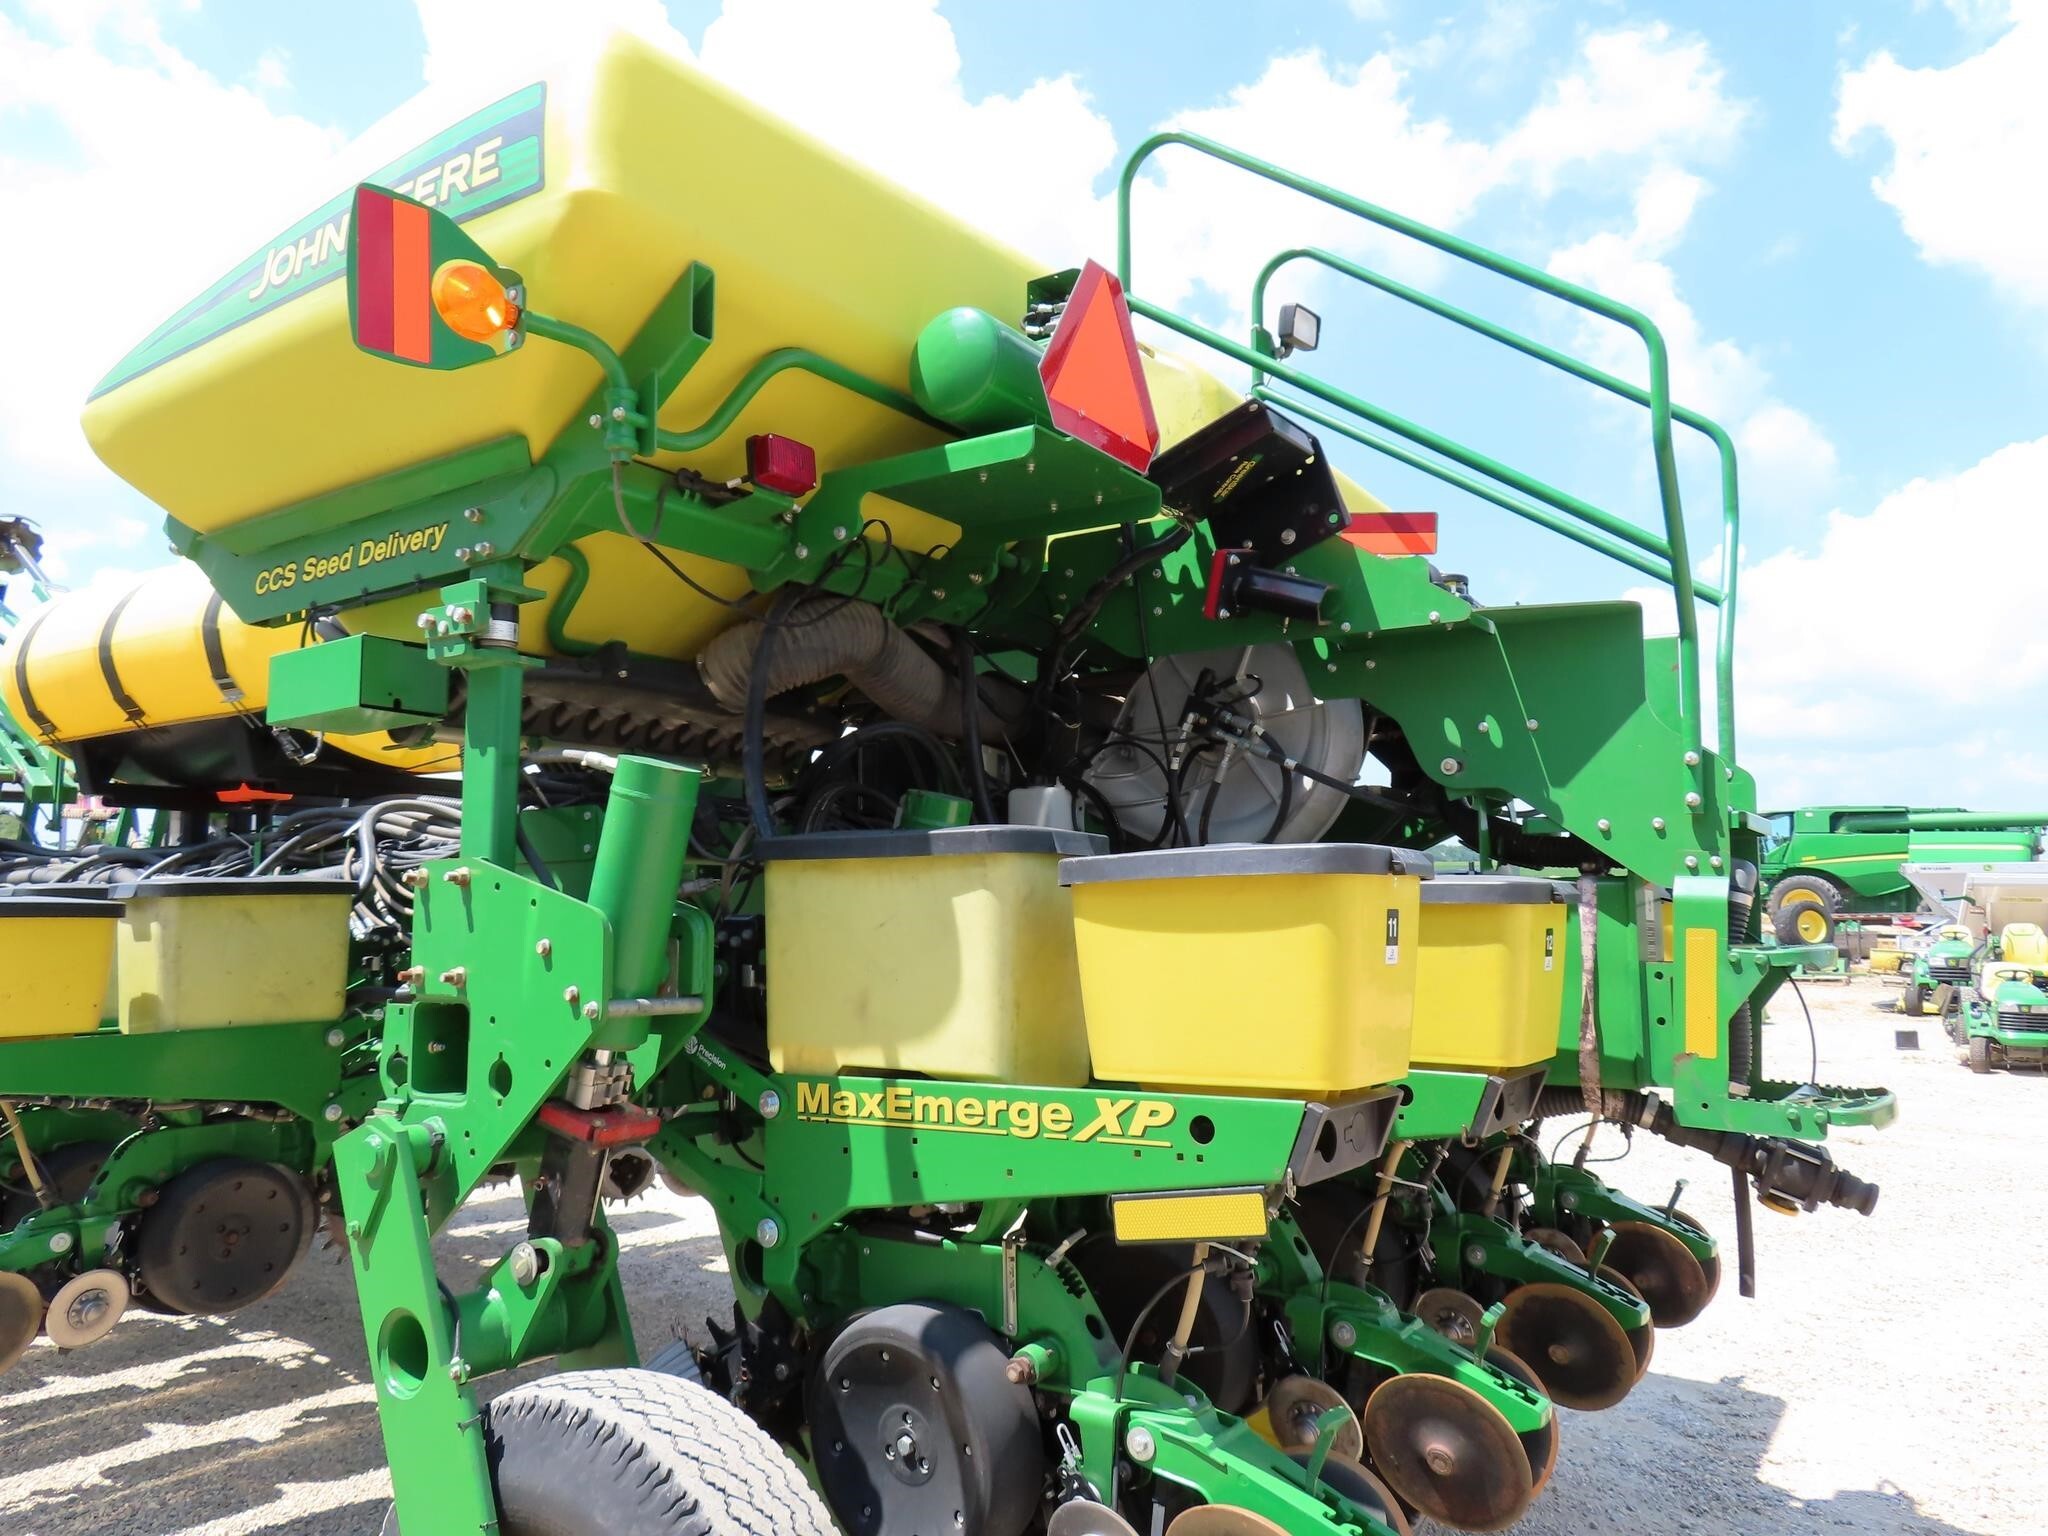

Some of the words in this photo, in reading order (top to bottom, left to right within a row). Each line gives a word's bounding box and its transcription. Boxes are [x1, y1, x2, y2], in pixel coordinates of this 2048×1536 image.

[248, 212, 351, 301] JOHN
[393, 135, 503, 208] ERE
[255, 562, 297, 596] CCS
[302, 545, 354, 582] Seed
[358, 521, 449, 567] Delivery
[1388, 917, 1397, 938] 11
[797, 1082, 1073, 1139] MaxEmerge
[1071, 1097, 1176, 1142] XP
